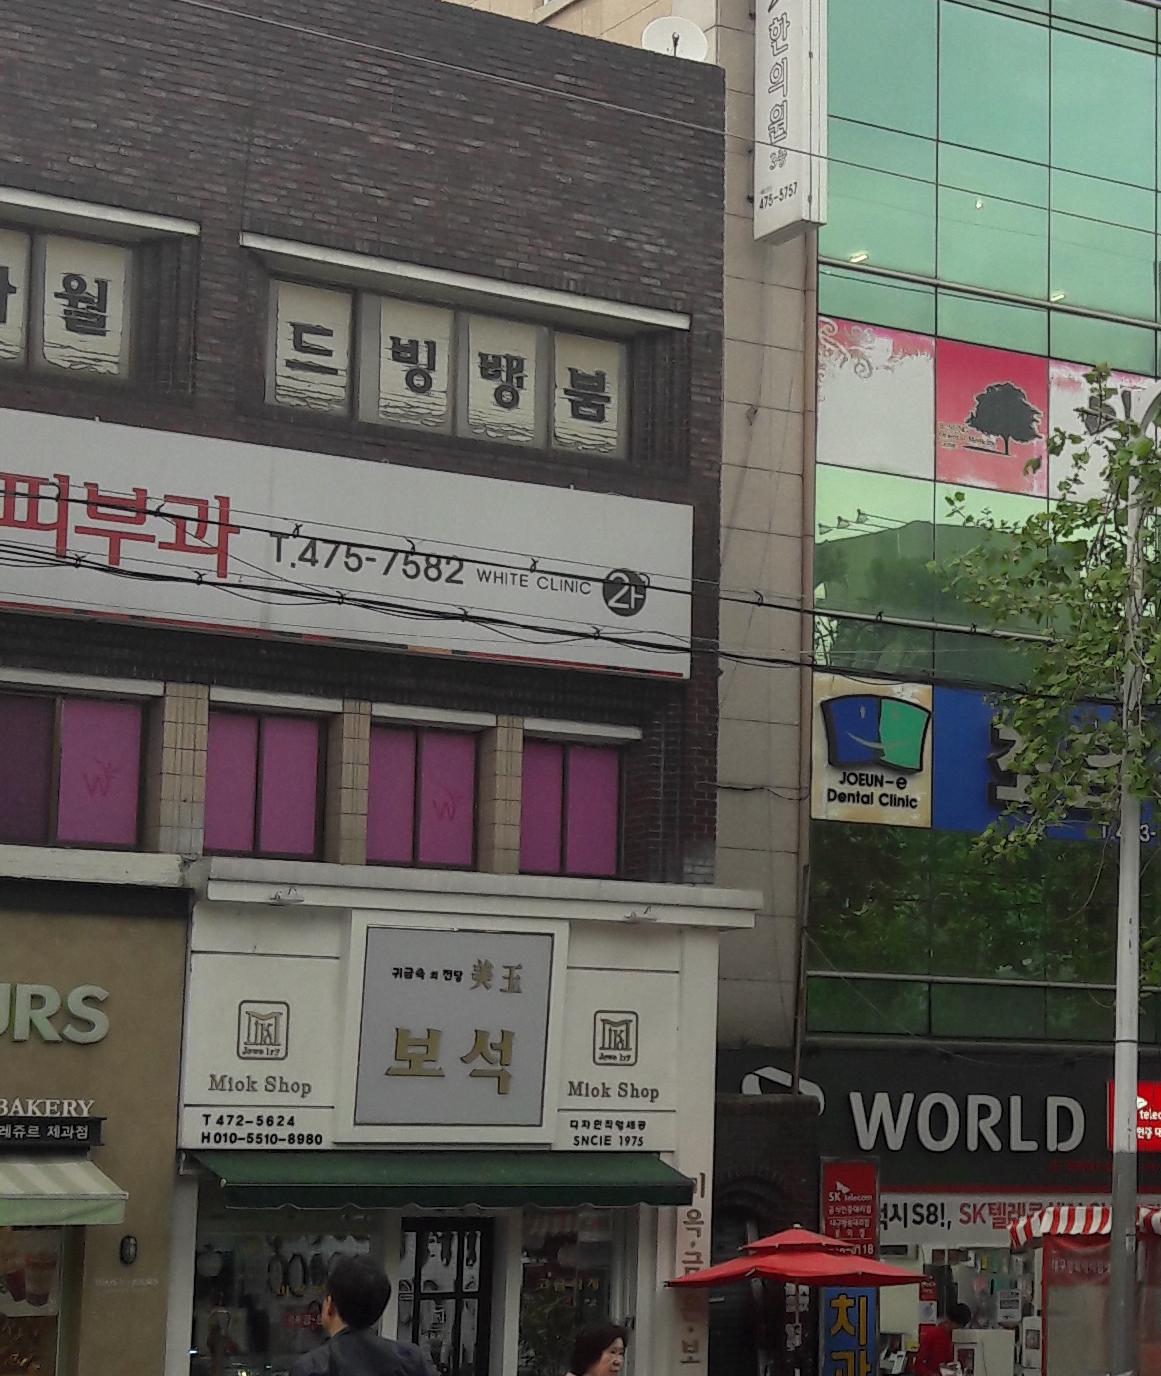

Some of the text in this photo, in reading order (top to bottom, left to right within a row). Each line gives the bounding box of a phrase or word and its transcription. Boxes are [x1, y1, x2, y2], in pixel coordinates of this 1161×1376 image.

[759, 182, 798, 209] 475-5757
[269, 531, 465, 585] T.475-7582
[476, 567, 529, 588] WHITE
[536, 575, 592, 596] CLINIC
[827, 788, 918, 809] Dental Clinic
[0, 983, 110, 1045] RS
[384, 1028, 516, 1095] 보석
[208, 1074, 312, 1097] Miok Shop
[567, 1080, 660, 1103] Miok Shop
[47, 1125, 89, 1139] 제과점
[215, 1115, 296, 1126] 472-5624
[849, 1091, 1086, 1152] WORLD
[619, 1135, 645, 1146] 1975
